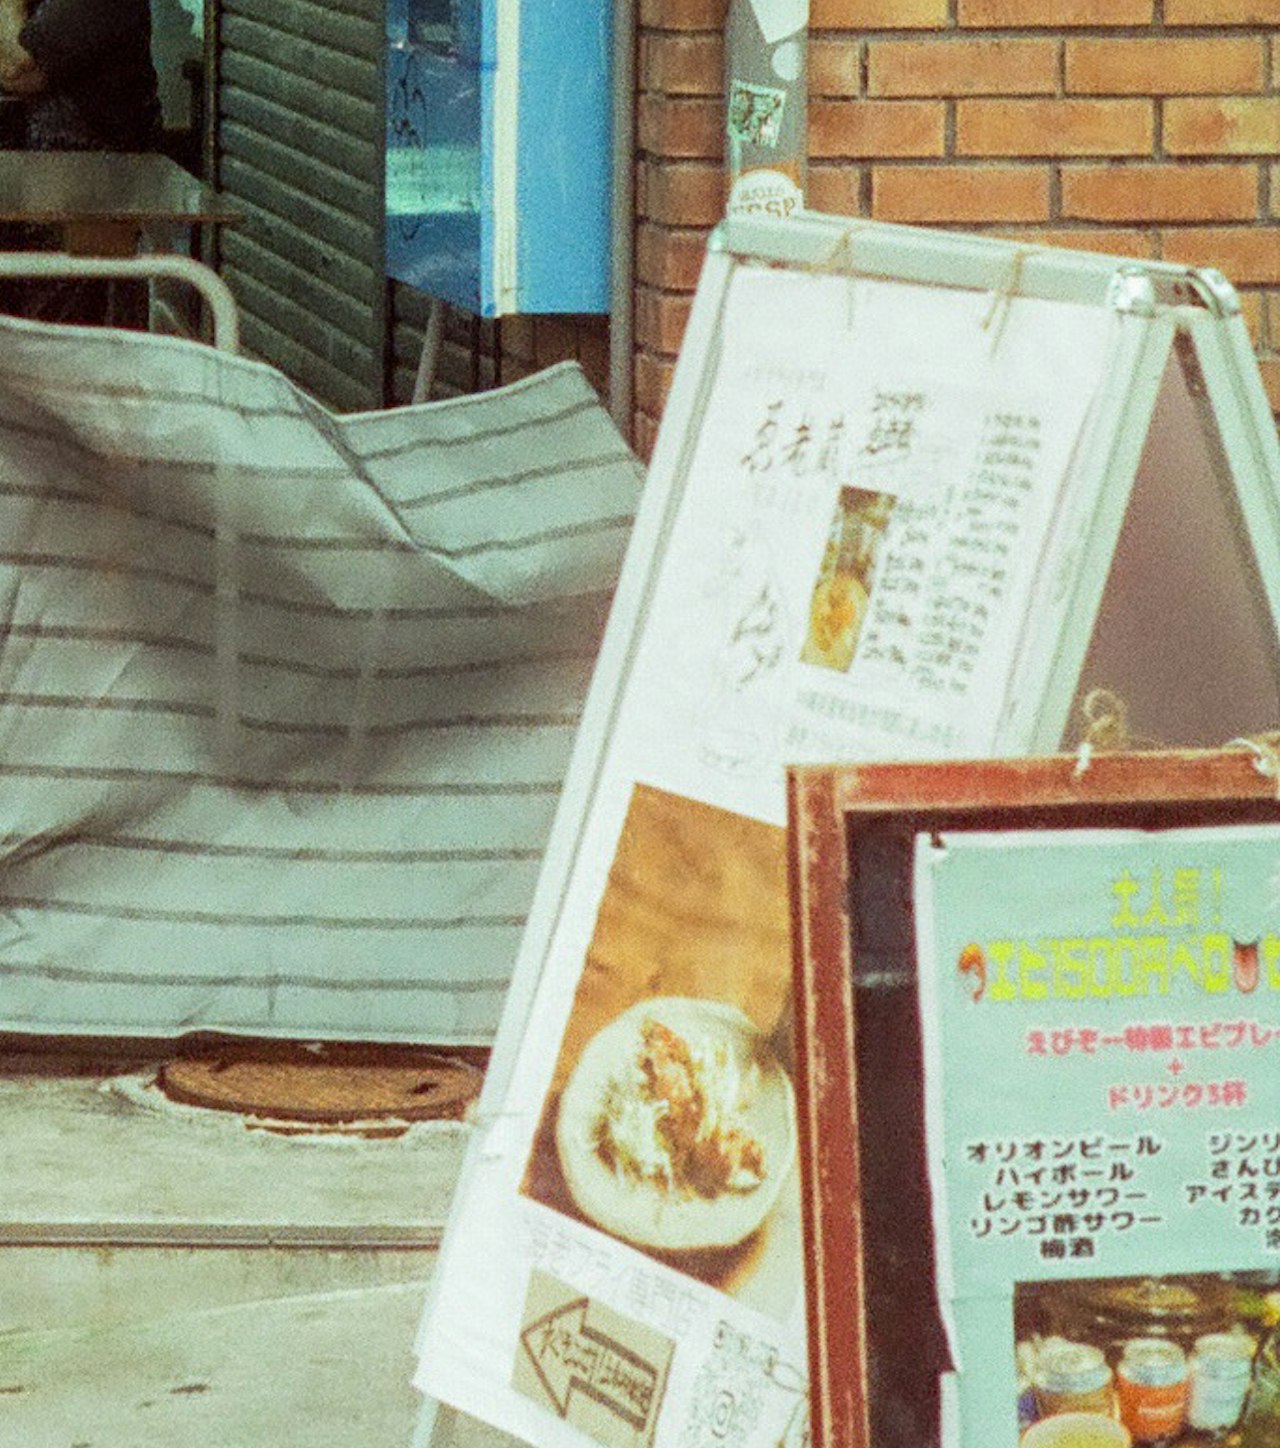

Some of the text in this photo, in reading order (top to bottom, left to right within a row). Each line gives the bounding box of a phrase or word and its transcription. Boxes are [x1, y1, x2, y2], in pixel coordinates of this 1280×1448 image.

[966, 1136, 1162, 1163] オリオンビール
[995, 1162, 1134, 1187] ハイボール
[983, 1187, 1148, 1212] レモンサワー
[970, 1210, 1163, 1239] リンゴ酢サワー
[1040, 1237, 1095, 1260] 梅酒
